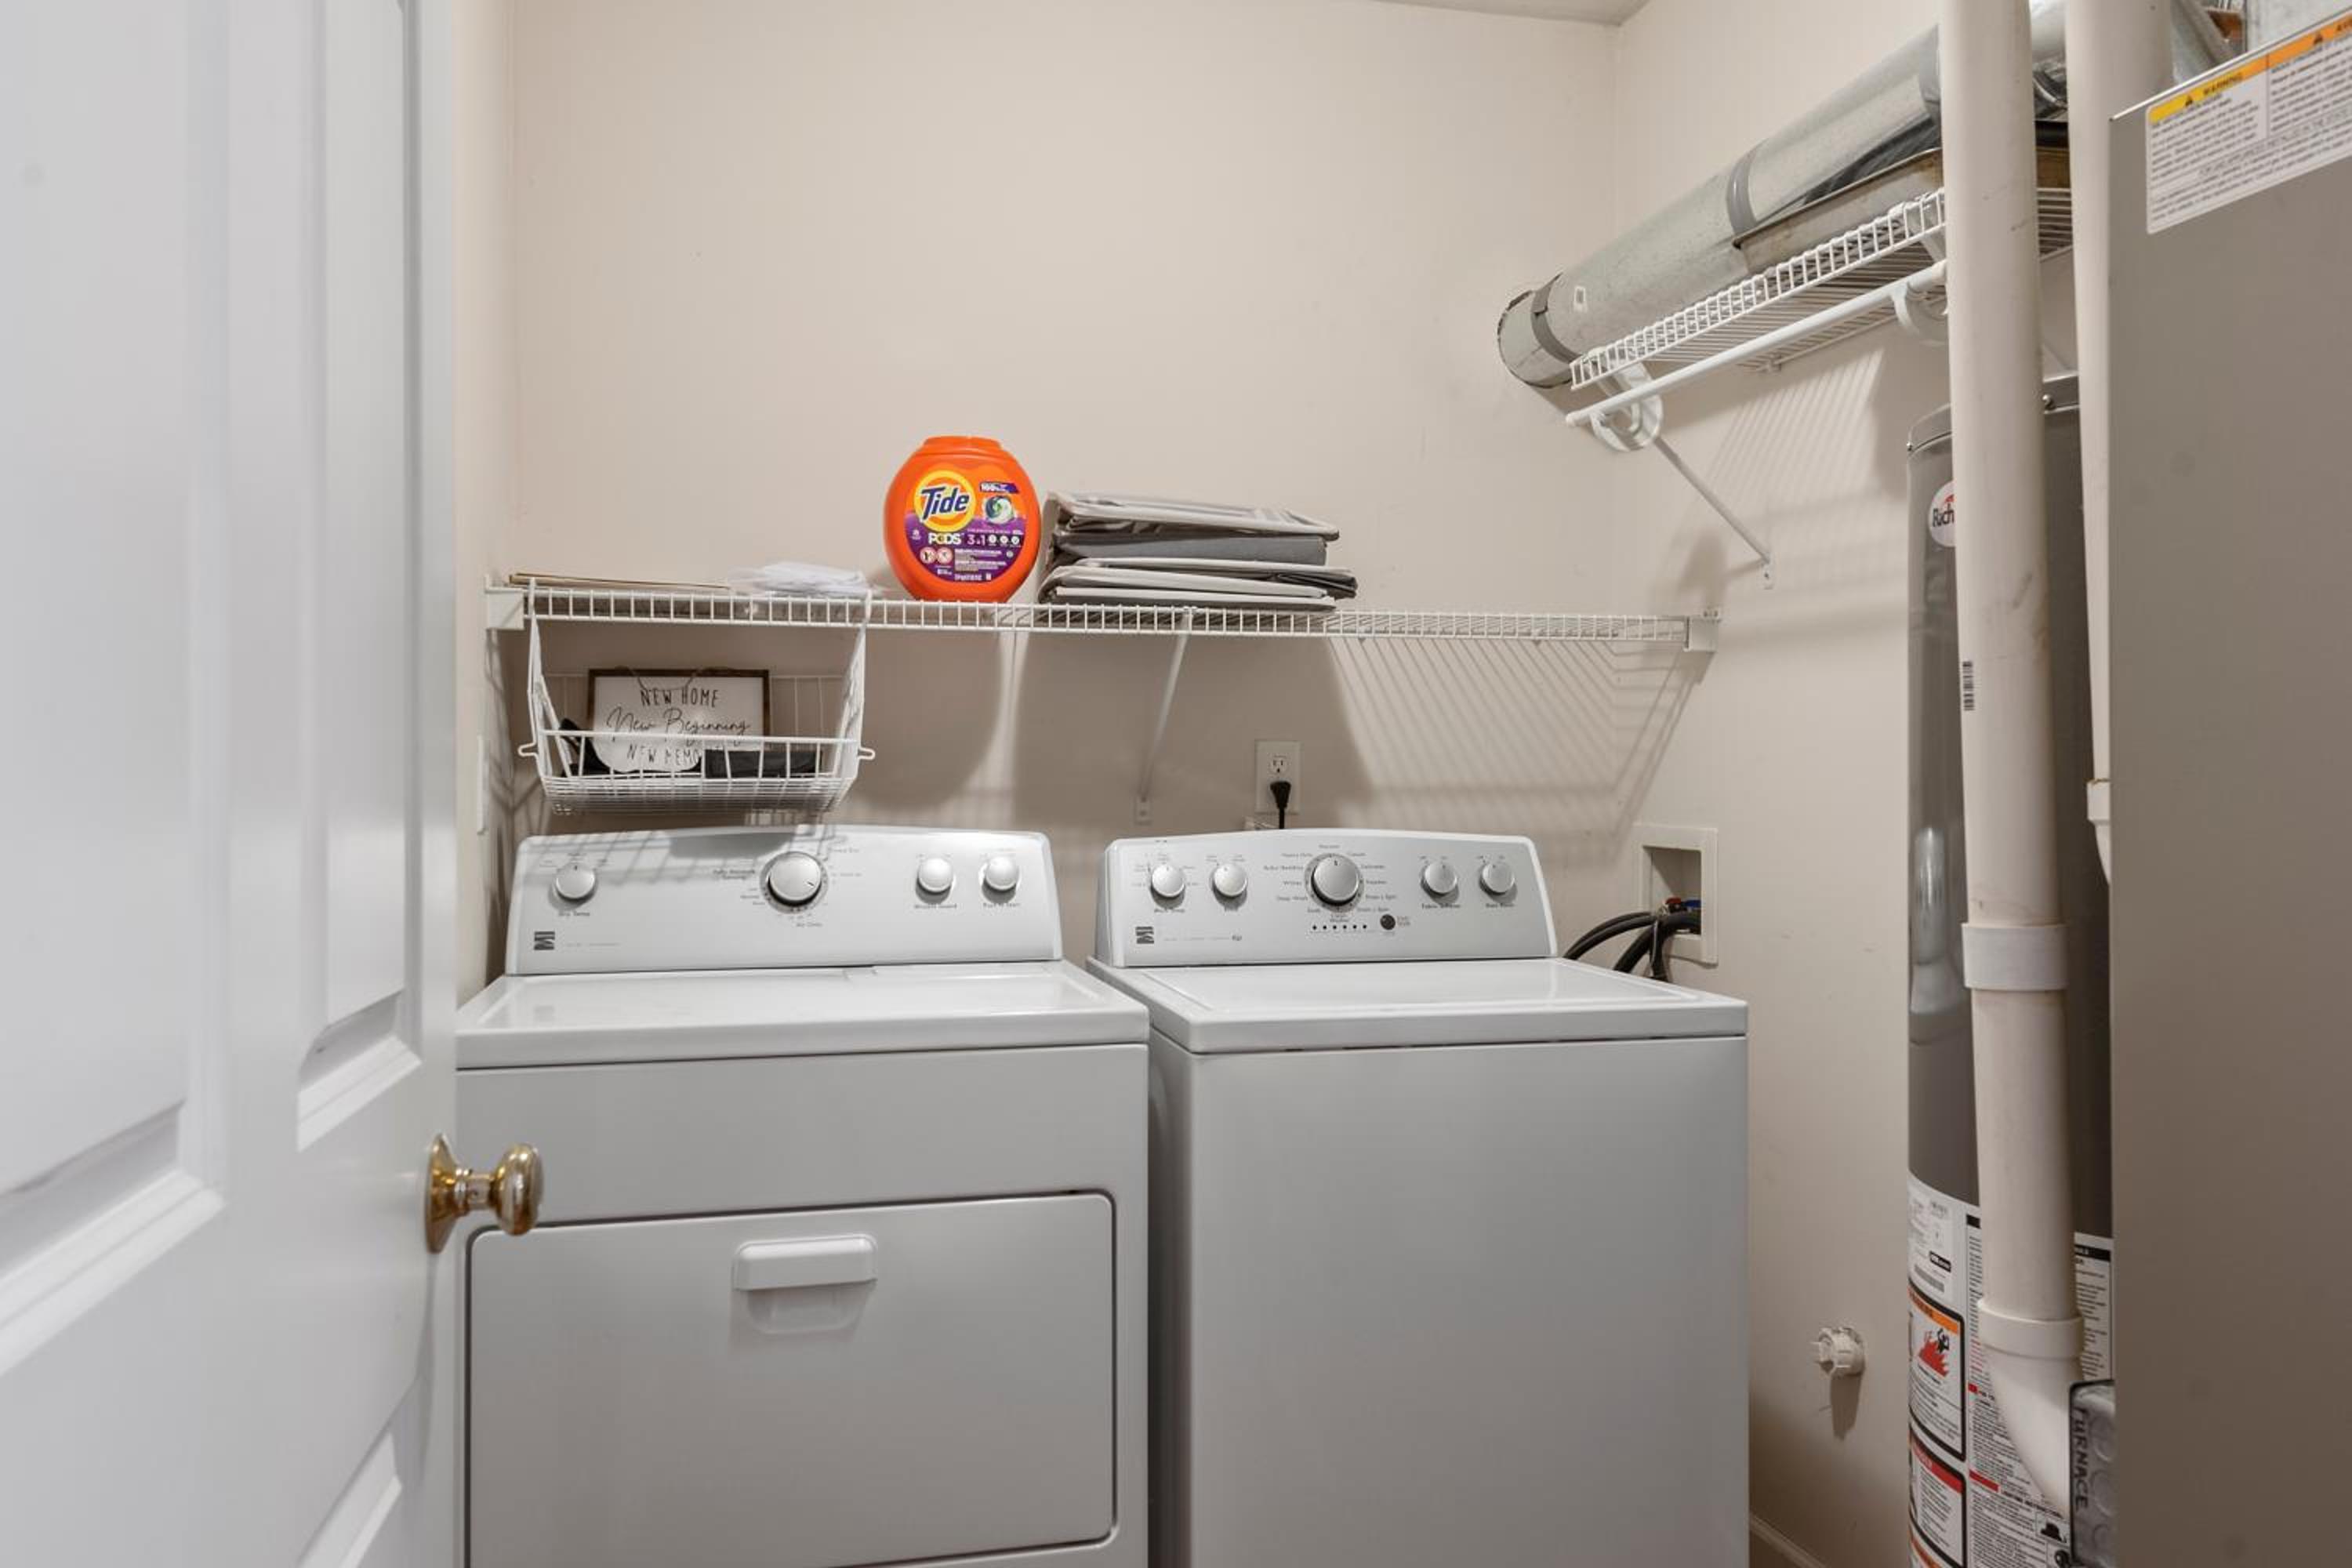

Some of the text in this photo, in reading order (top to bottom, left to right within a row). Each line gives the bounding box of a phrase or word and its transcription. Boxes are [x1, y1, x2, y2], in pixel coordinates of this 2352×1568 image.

[920, 485, 970, 521] Tide
[928, 533, 961, 545] PODS
[640, 688, 720, 708] NEW HOME
[605, 706, 656, 741] New
[2073, 1406, 2089, 1512] FURNACE
